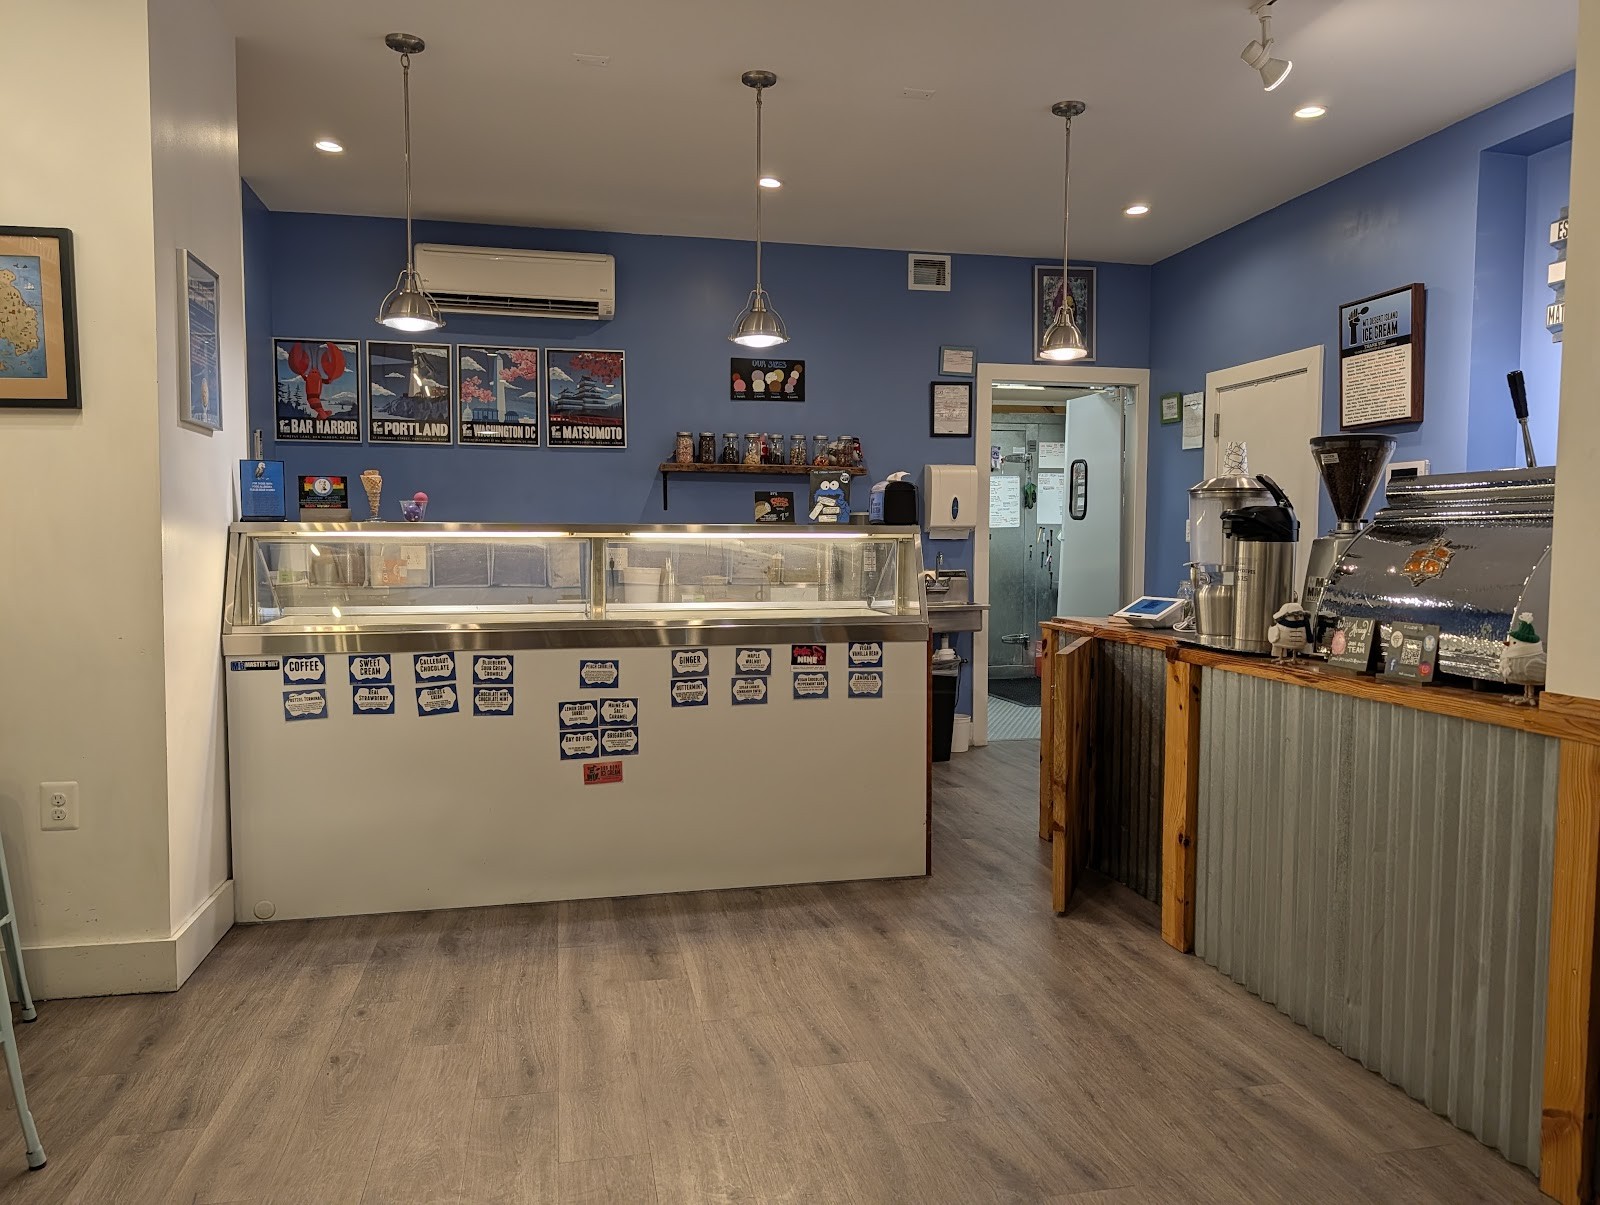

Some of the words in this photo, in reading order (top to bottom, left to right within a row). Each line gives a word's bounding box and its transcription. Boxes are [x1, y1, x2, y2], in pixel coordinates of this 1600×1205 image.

[1370, 314, 1384, 326] DESERT
[1384, 310, 1398, 322] ISLAND
[1362, 326, 1372, 342] ICE
[1374, 320, 1398, 339] CREAM
[291, 420, 313, 434] BAR
[316, 420, 358, 435] HARBOR
[384, 422, 448, 436] PORTLAND
[474, 425, 524, 438] WASHINGTON
[525, 426, 536, 438] DC
[563, 426, 622, 440] MATSUMOTO
[289, 660, 319, 672] COFFEE
[359, 659, 380, 667] SWEET
[680, 656, 701, 664] GINGER
[360, 667, 380, 676] CREAM
